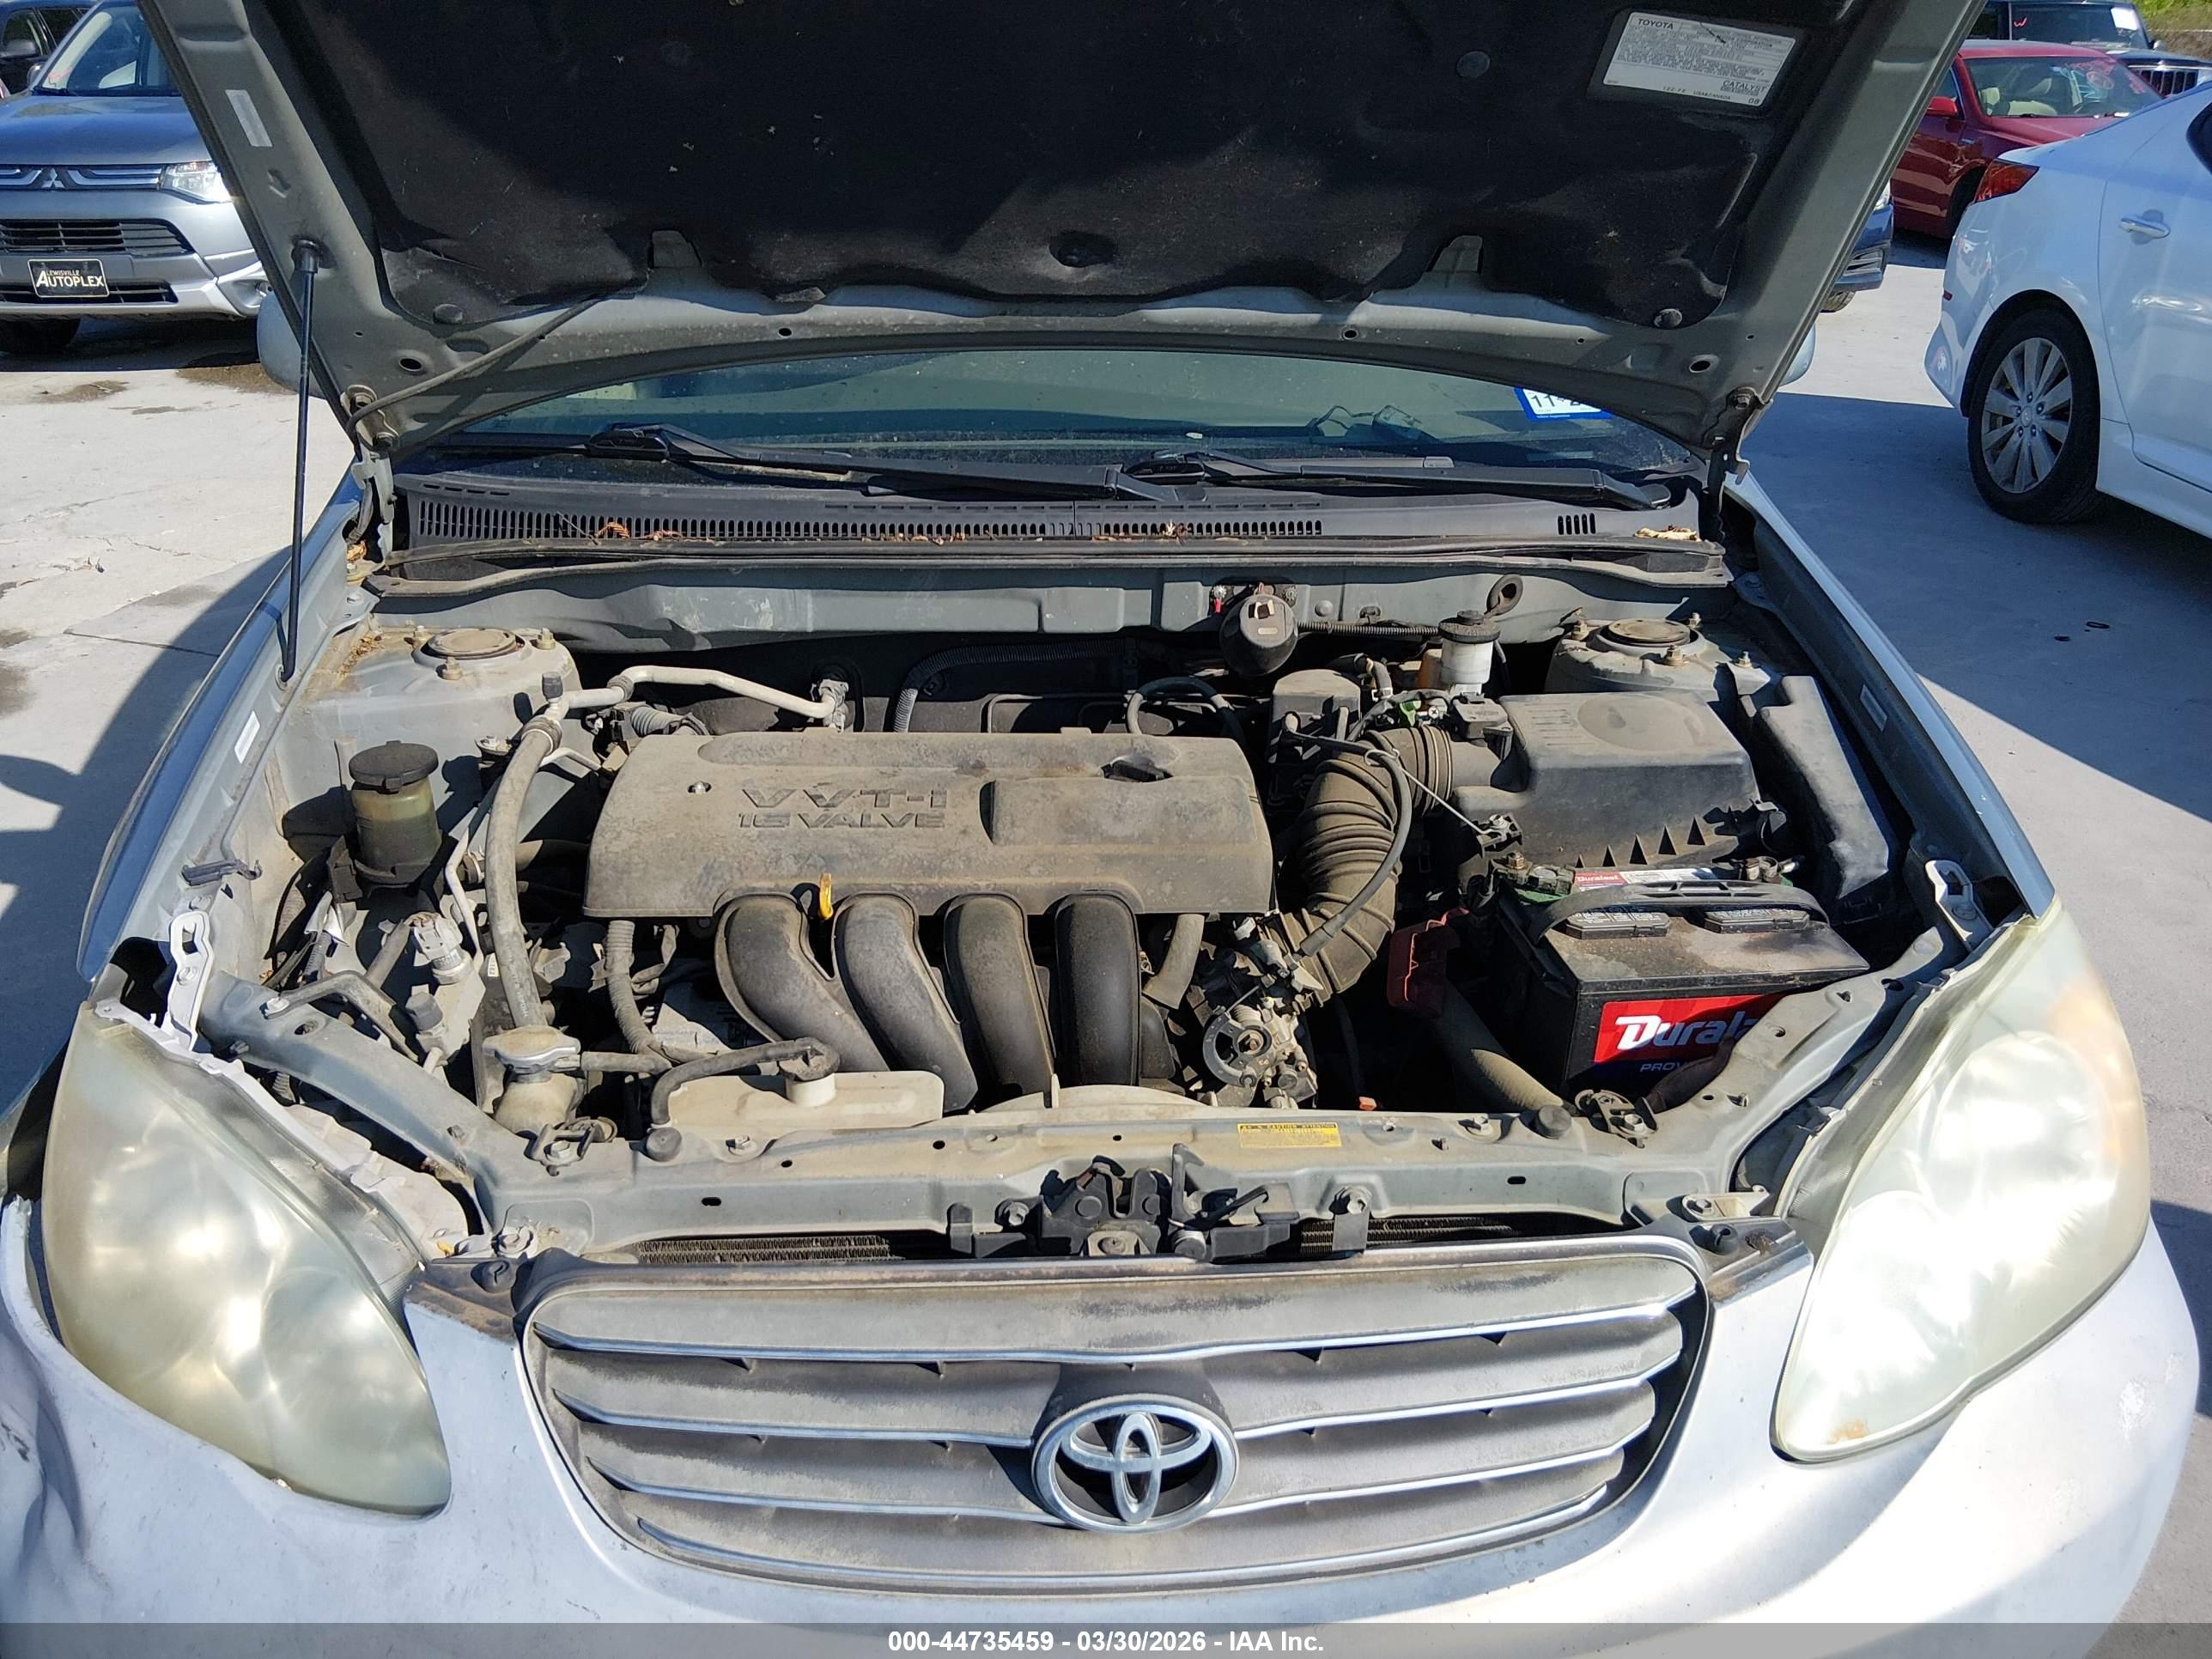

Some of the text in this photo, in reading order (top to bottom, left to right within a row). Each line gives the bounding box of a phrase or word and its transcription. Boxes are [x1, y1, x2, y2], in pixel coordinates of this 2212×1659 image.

[1638, 18, 1674, 30] TOYOTA
[1723, 80, 1767, 93] CATALYST
[36, 270, 104, 287] AUTOPLEX
